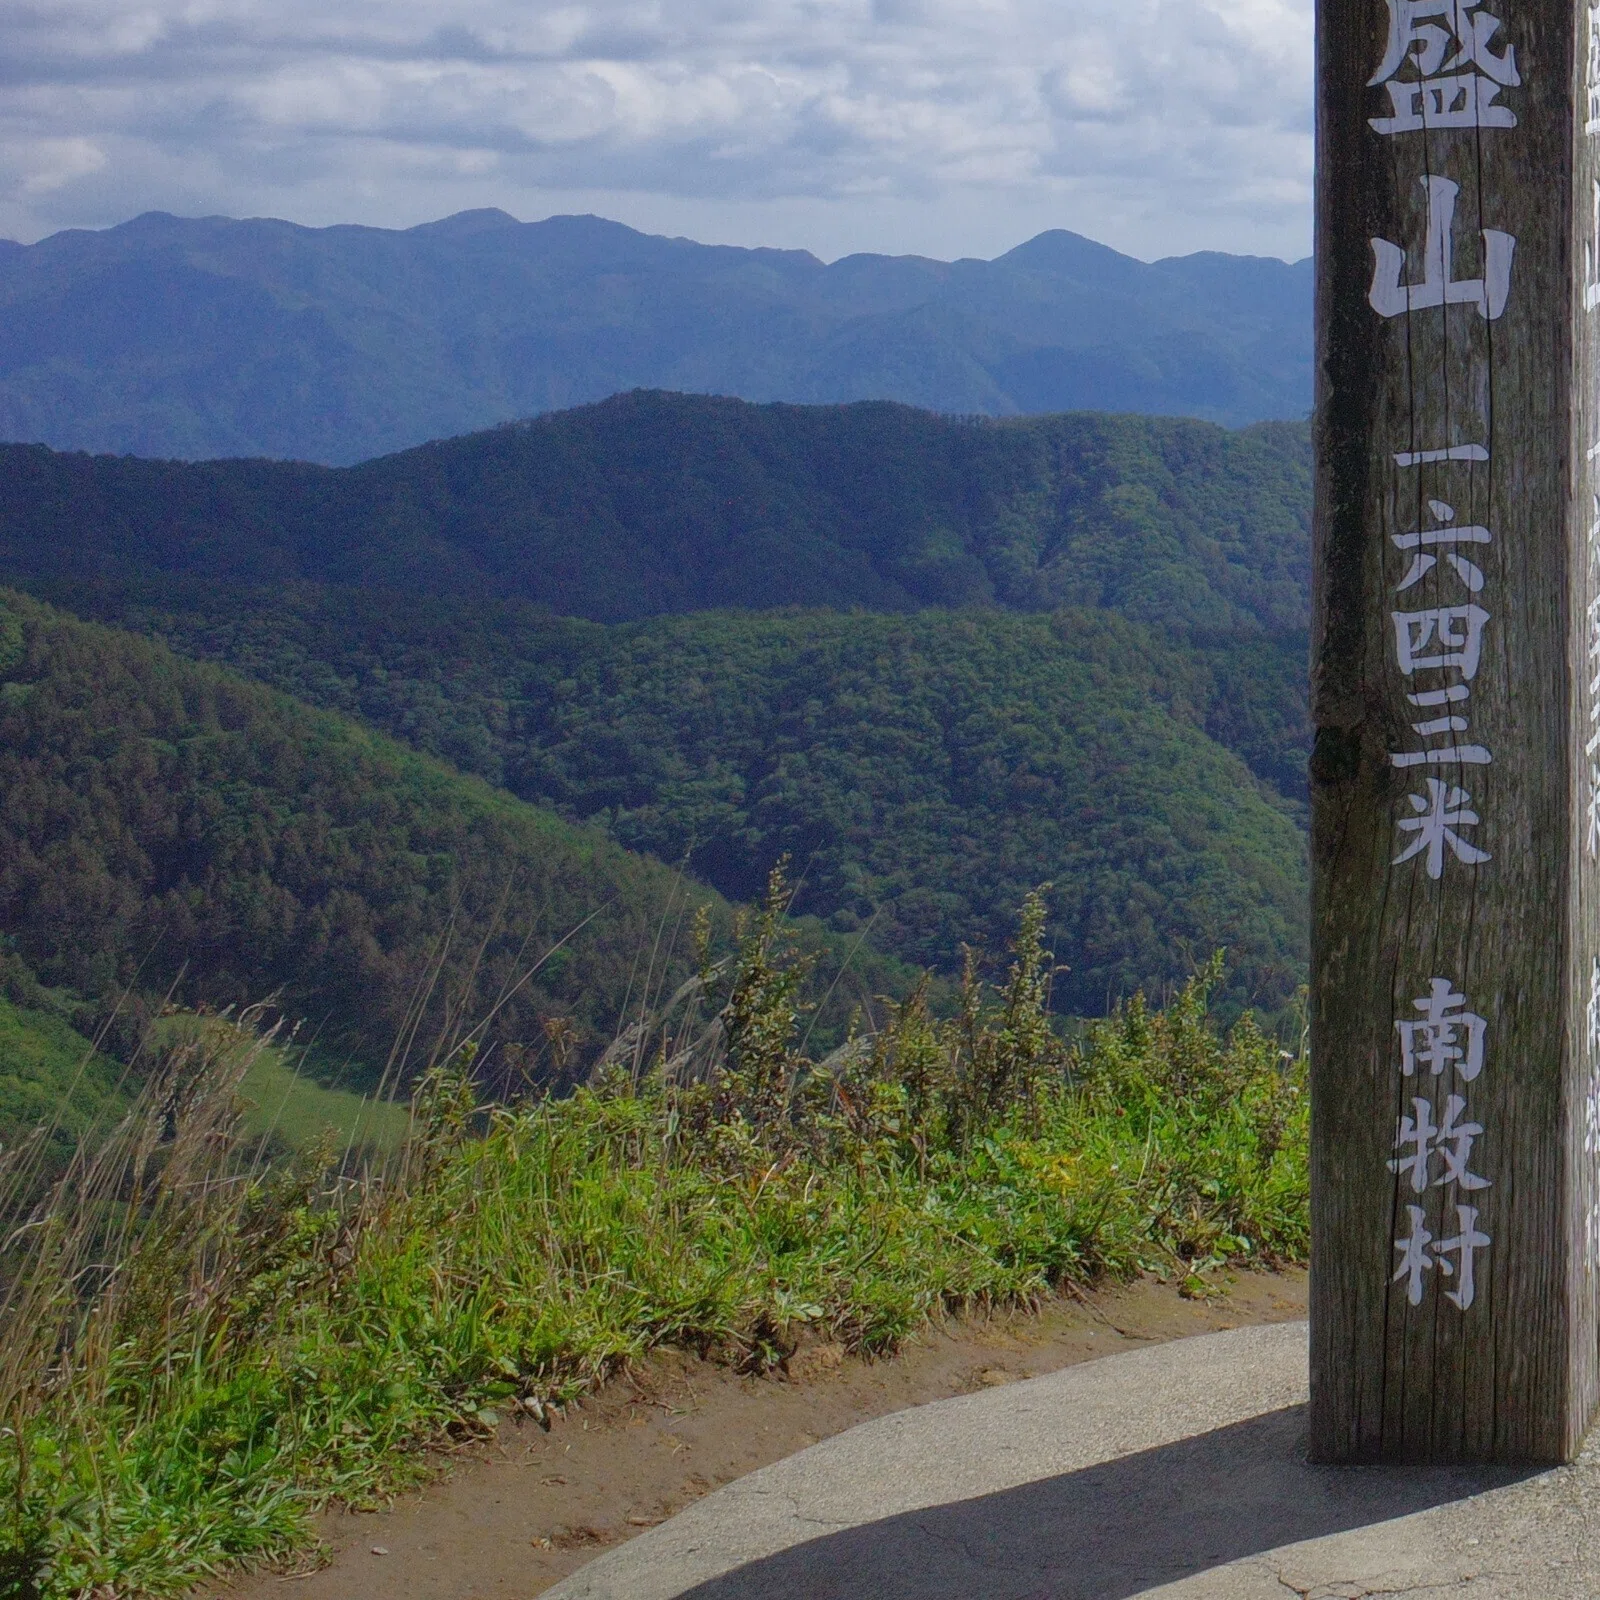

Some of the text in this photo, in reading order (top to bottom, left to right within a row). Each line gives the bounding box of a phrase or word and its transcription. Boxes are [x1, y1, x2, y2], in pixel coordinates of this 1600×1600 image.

[1392, 442, 1492, 879] 一六四三米
[1387, 977, 1492, 1311] 南牧村
